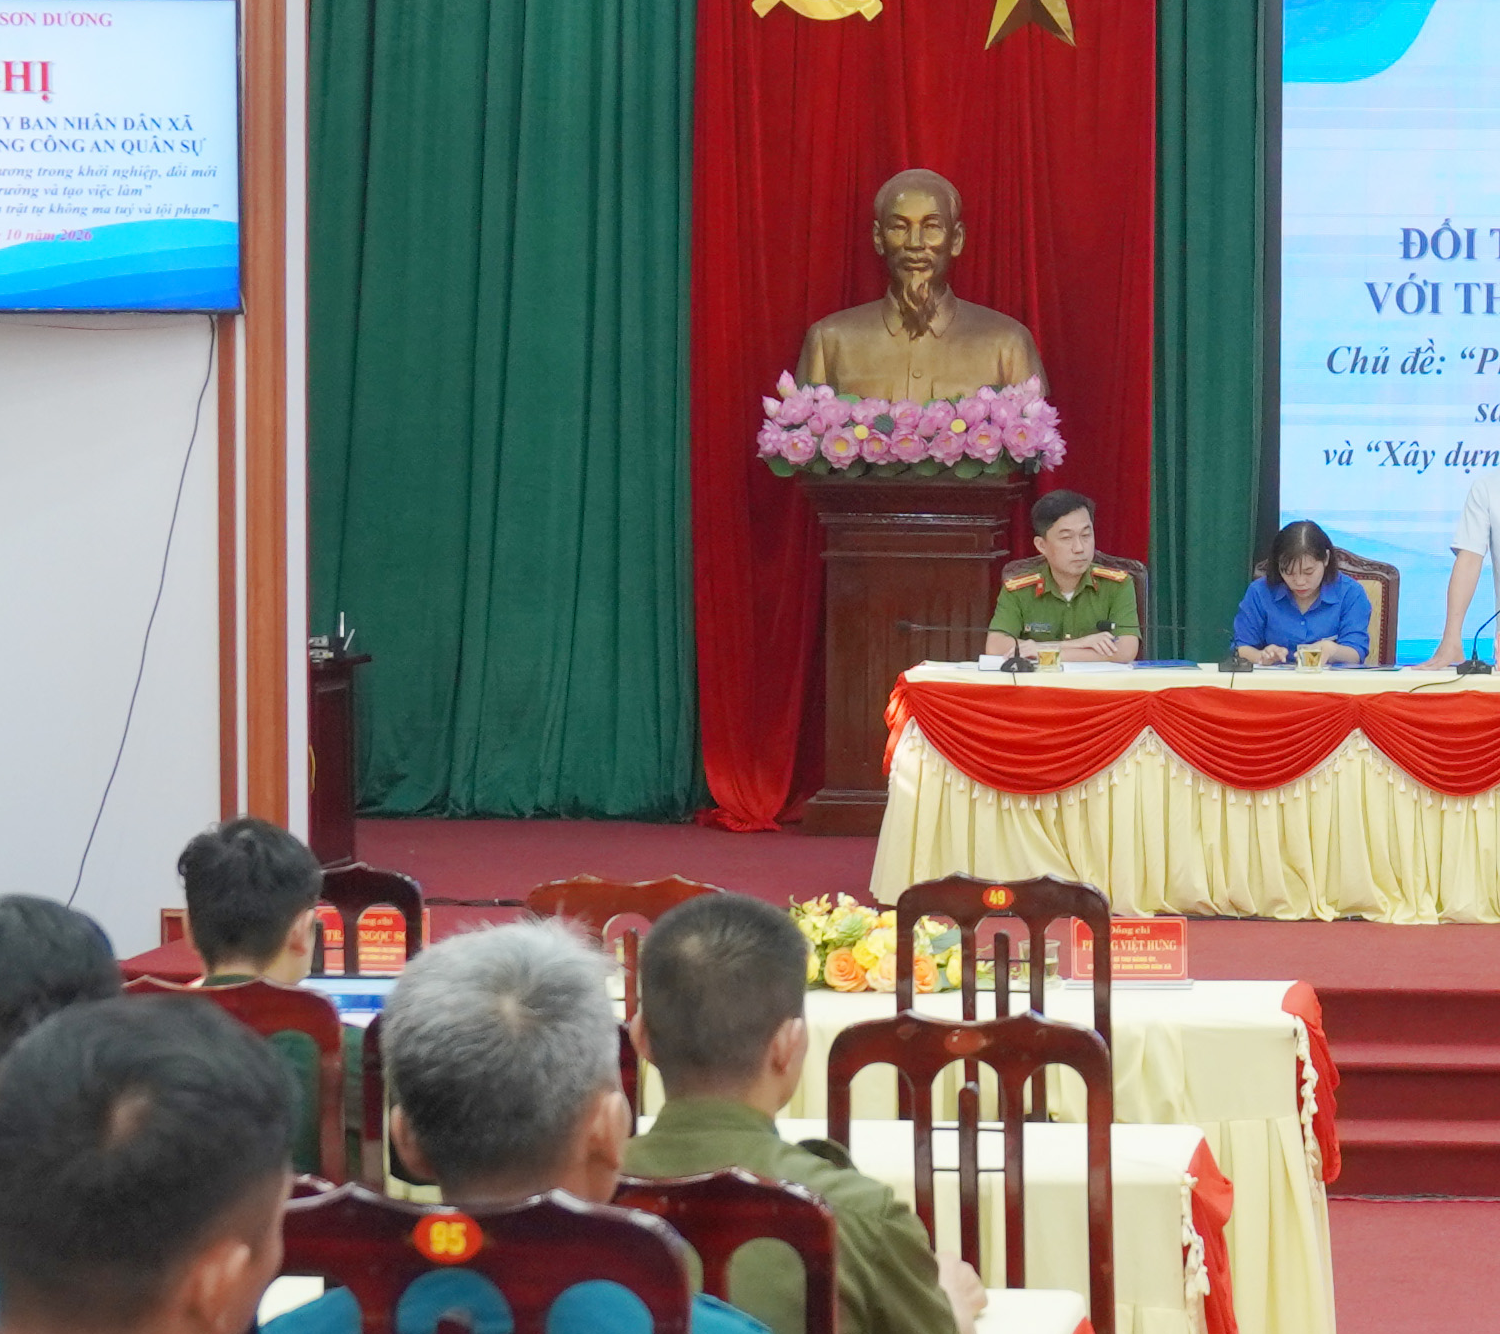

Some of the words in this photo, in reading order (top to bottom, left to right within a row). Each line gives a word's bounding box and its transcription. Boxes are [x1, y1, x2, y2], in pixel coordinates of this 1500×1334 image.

[5, 228, 22, 241] 10
[1399, 219, 1477, 261] ĐỐI
[1364, 273, 1441, 315] VỚI
[1326, 344, 1390, 375] Chủ
[1400, 339, 1446, 377] đề:
[1323, 440, 1354, 466] và
[1367, 440, 1436, 475] “Xây
[988, 889, 1006, 906] 49
[429, 1220, 468, 1256] 95
